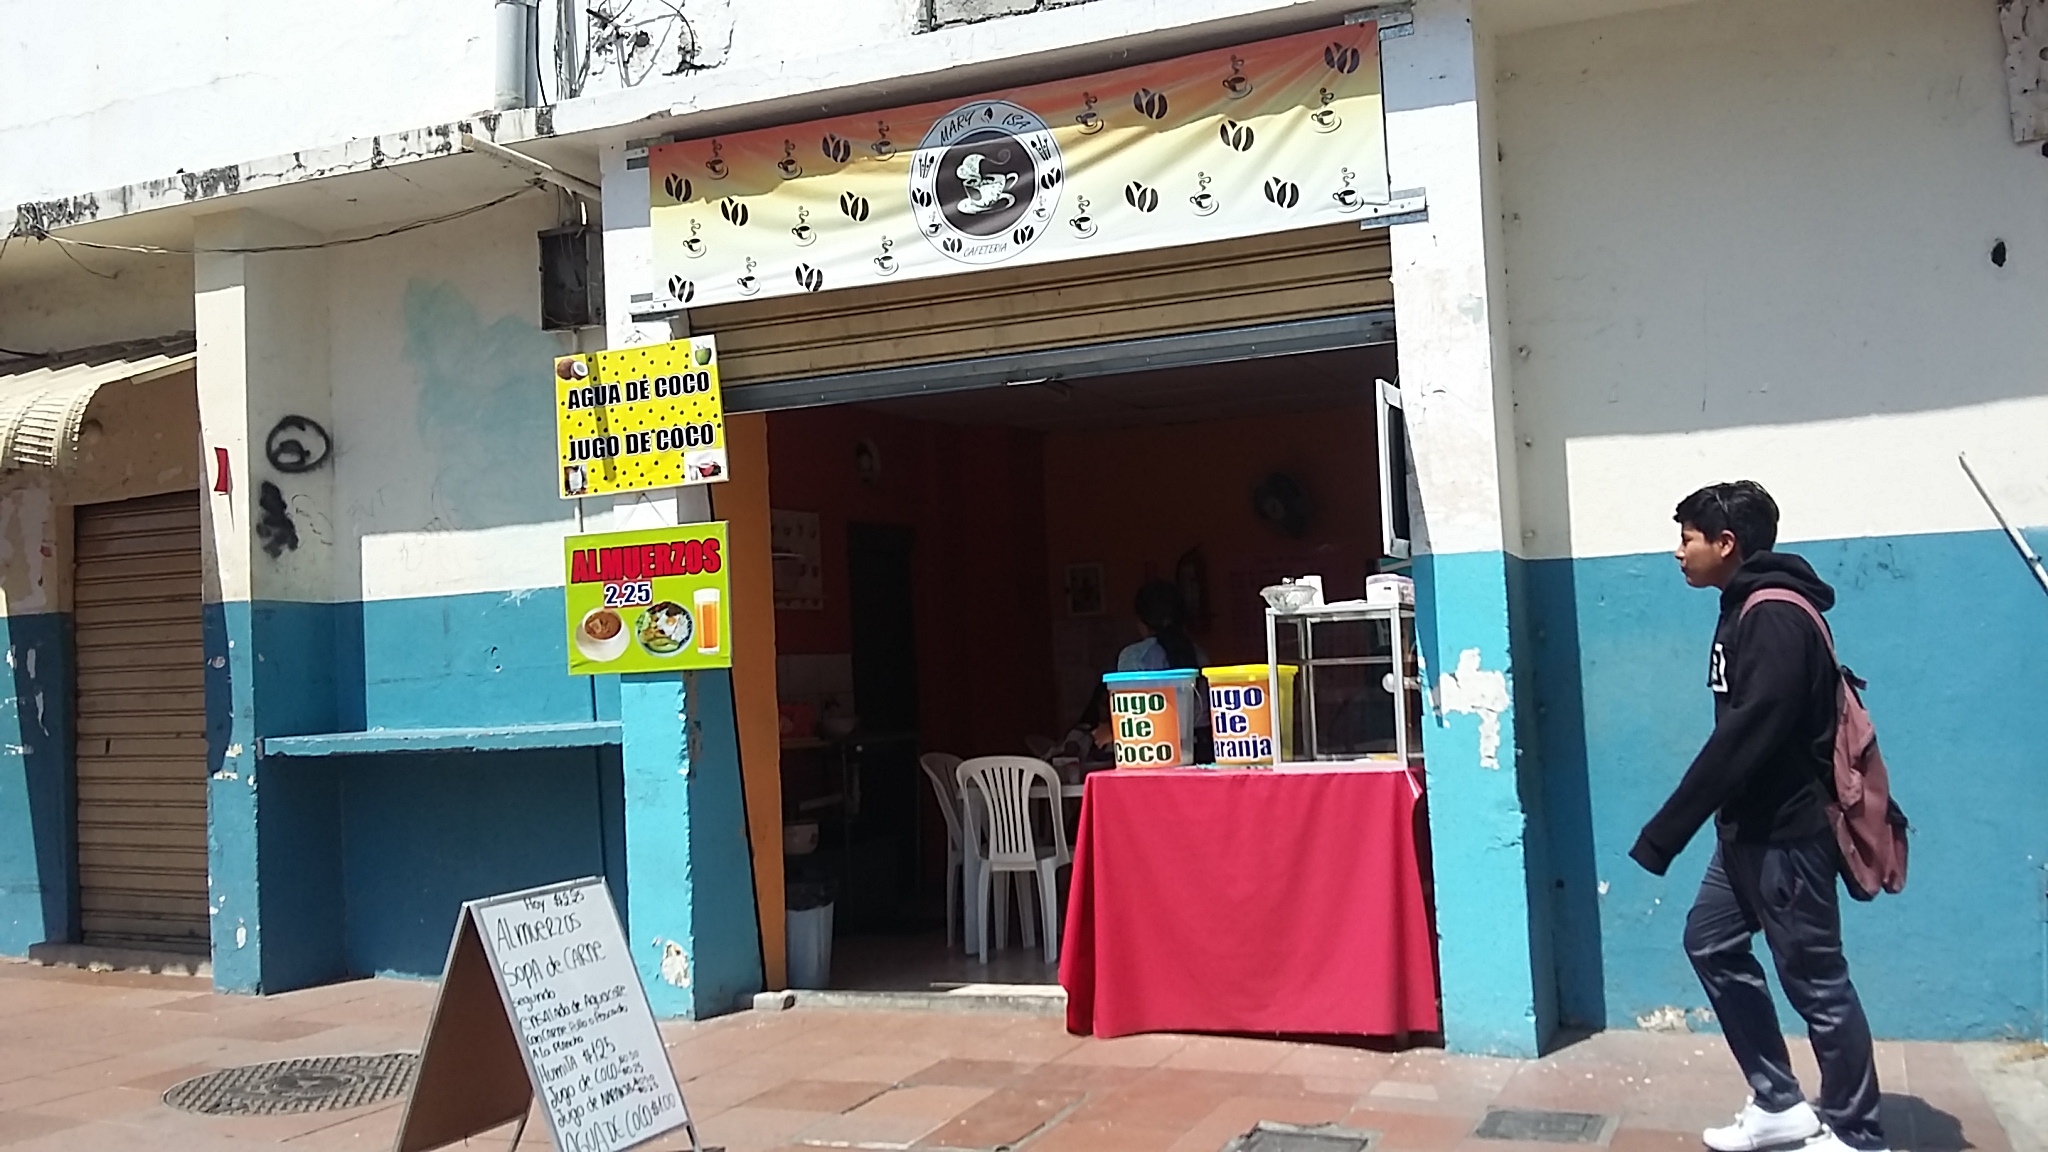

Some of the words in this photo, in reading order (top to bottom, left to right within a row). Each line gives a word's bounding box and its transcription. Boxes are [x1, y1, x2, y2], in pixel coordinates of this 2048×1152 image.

[940, 110, 976, 147] MARY
[1002, 112, 1031, 130] ISA
[963, 242, 1008, 258] CAFETERIA
[567, 384, 621, 410] AGUA
[625, 380, 650, 402] DE
[654, 371, 710, 398] COCO
[568, 436, 619, 461] JUGO
[625, 431, 651, 455] DE
[656, 424, 714, 451] COCO
[571, 538, 721, 584] ALMUERZOS
[605, 583, 651, 606] 2,25
[1211, 687, 1262, 710] ugo
[1121, 718, 1151, 737] de
[1215, 712, 1247, 733] de
[523, 897, 545, 913] Hoy
